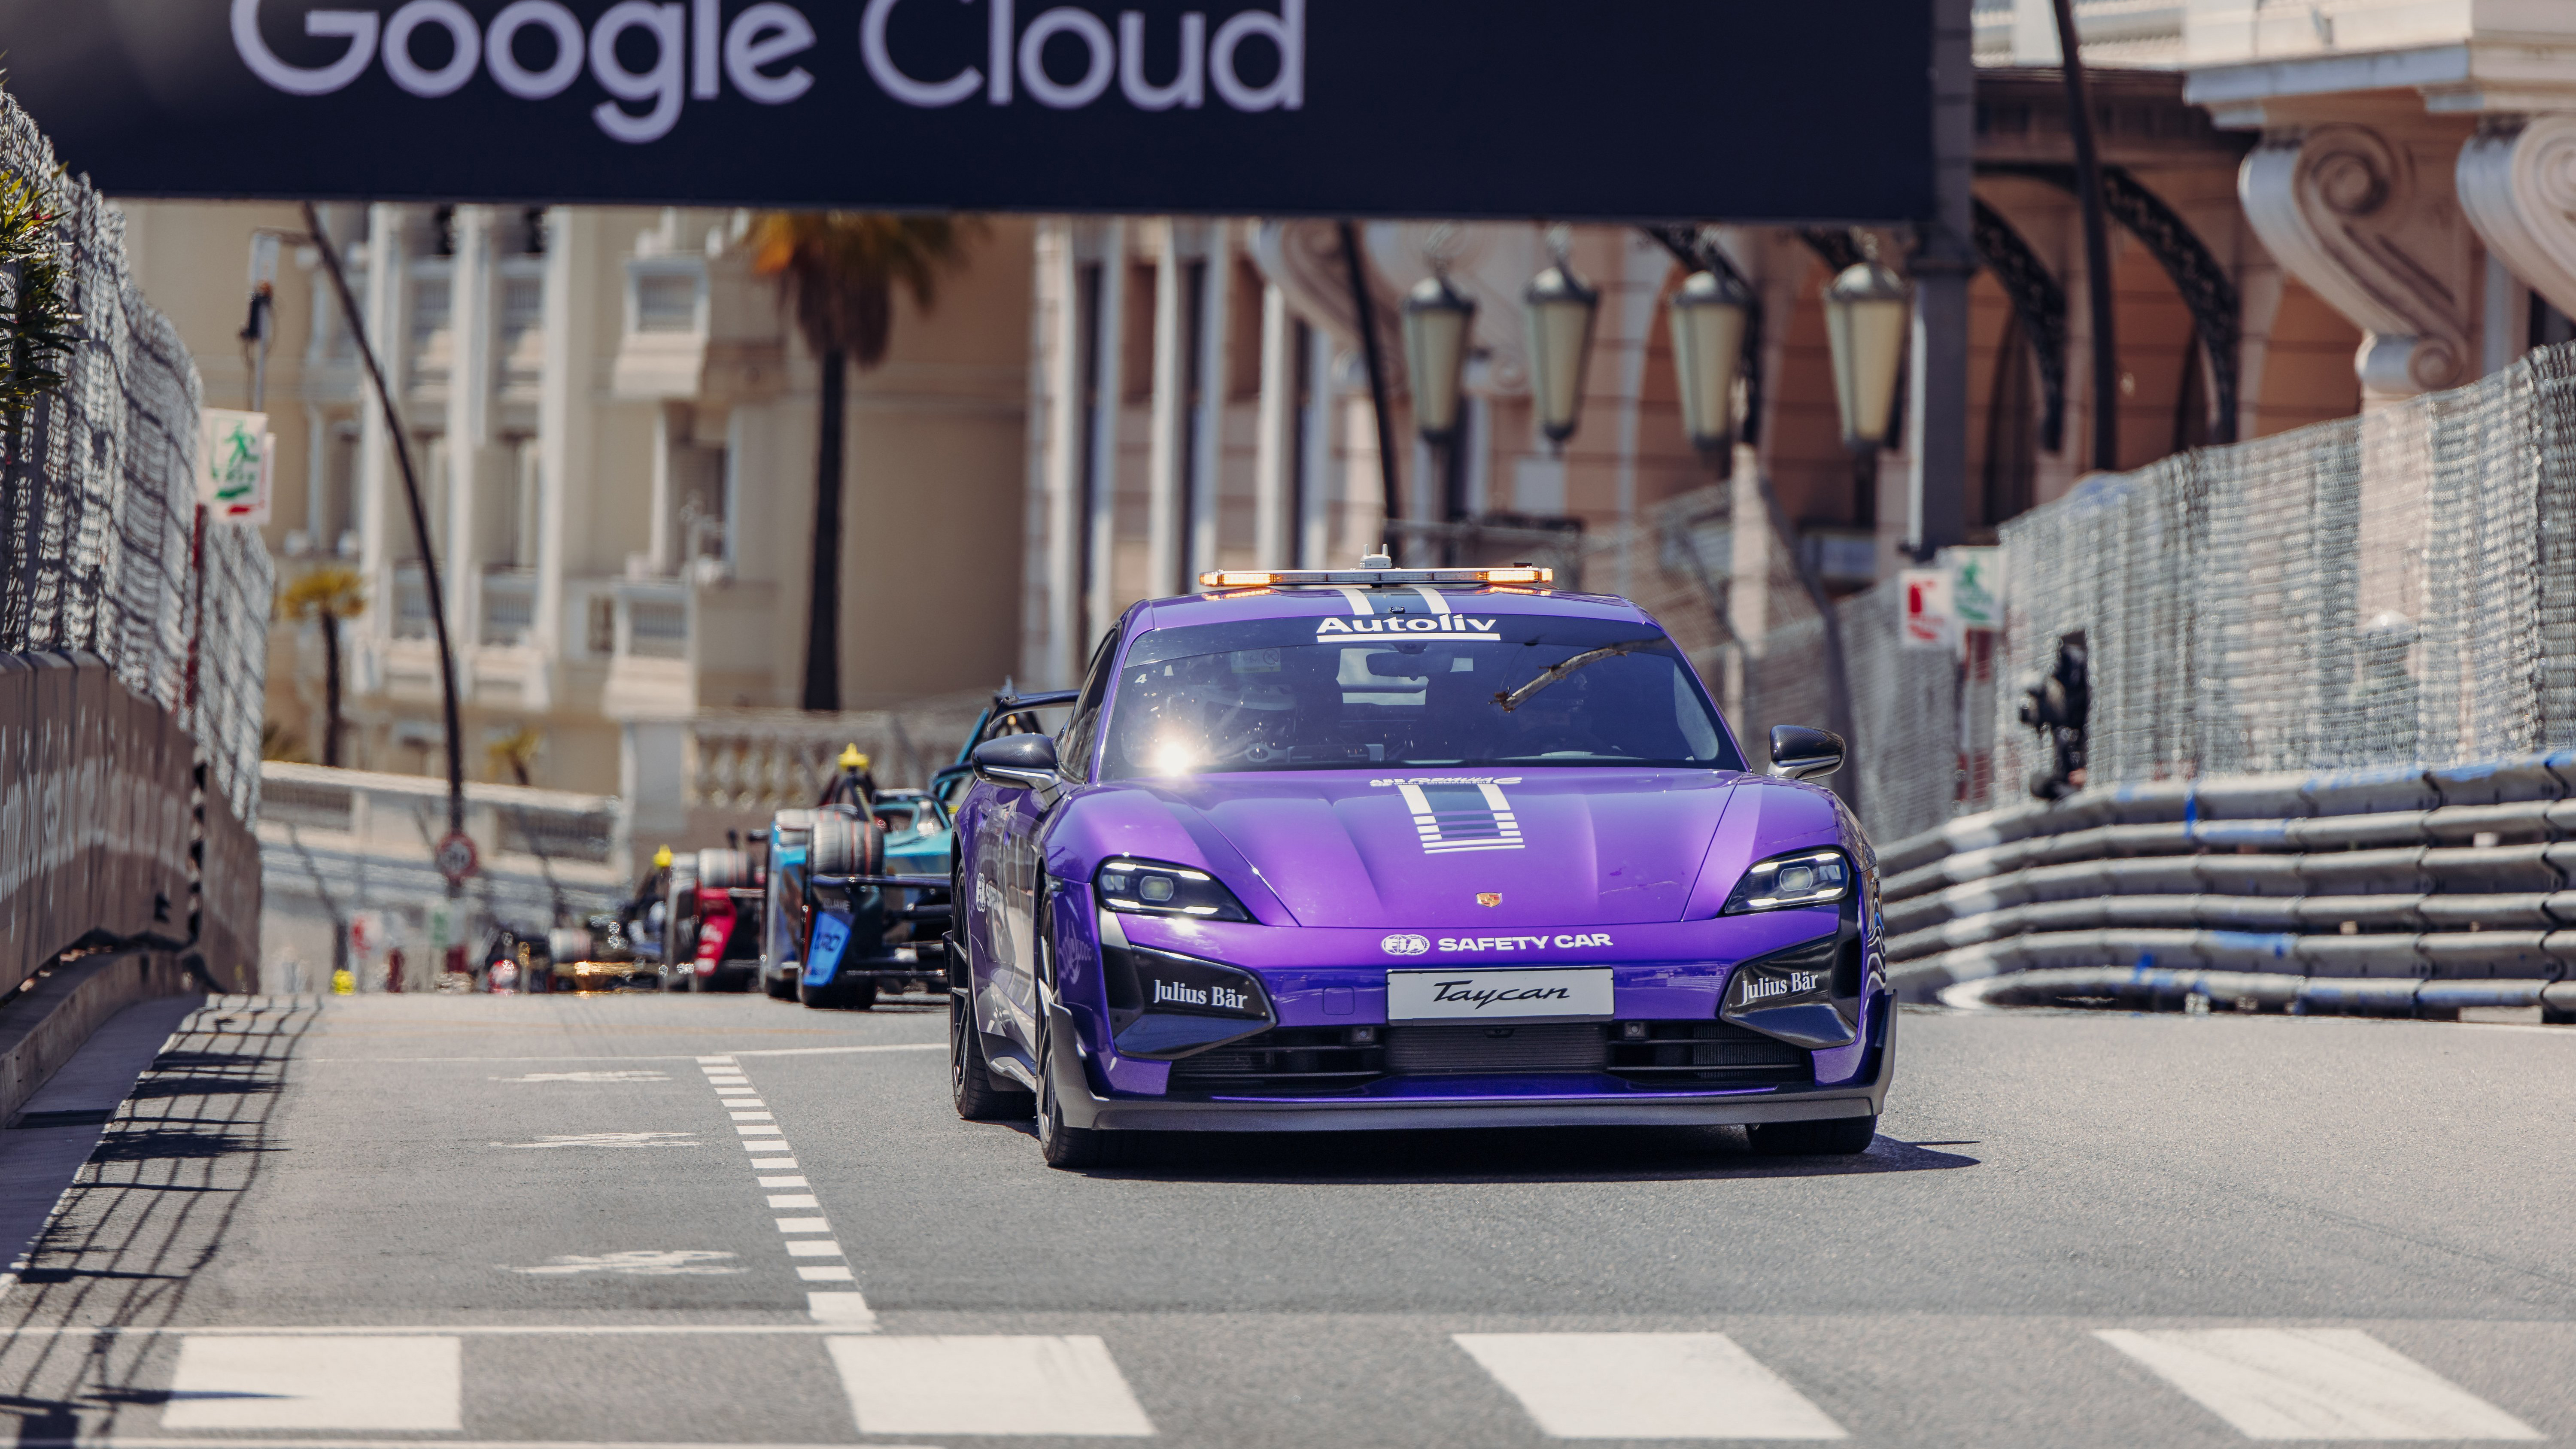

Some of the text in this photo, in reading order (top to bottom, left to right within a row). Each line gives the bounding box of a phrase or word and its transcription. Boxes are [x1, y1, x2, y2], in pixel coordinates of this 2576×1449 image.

[229, 0, 1305, 141] Google Cloud
[1316, 614, 1496, 633] Autoliv
[1135, 674, 1147, 683] 4
[1438, 936, 1549, 951] SAFETY
[1554, 933, 1613, 948] CAR
[1154, 979, 1248, 1009] Julius Bär
[1433, 980, 1570, 1010] Taycan
[1742, 970, 1819, 1004] Julius Bär
